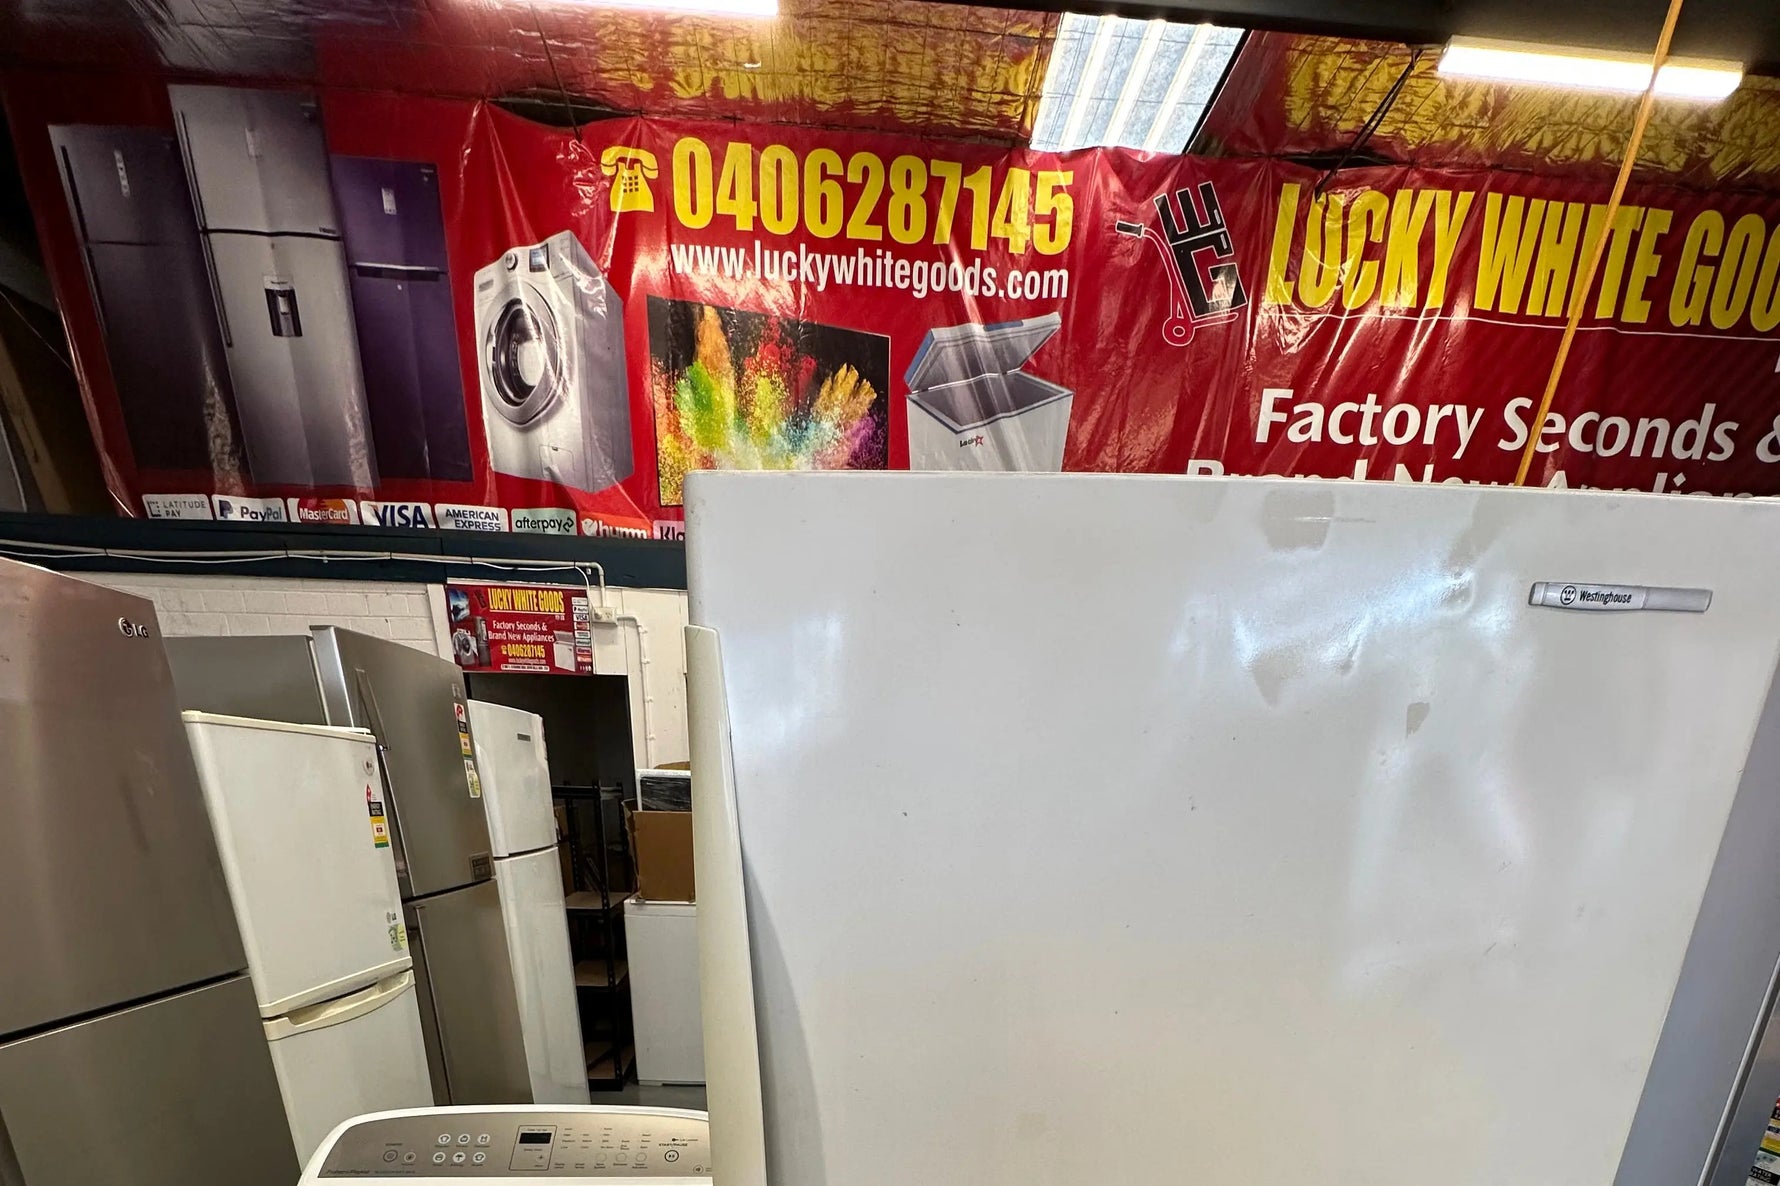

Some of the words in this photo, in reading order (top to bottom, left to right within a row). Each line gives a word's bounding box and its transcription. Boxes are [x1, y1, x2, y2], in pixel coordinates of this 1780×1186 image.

[672, 137, 1074, 255] 0406287145
[1264, 183, 1476, 310] LUCKY
[1474, 191, 1674, 323] WHITE
[670, 240, 1069, 300] www.luckywhitegoods.com
[1255, 388, 1485, 460] Factory
[1498, 396, 1740, 462] Seconds
[163, 500, 206, 509] LATITUDE
[165, 510, 181, 518] PAY
[240, 505, 282, 521] PayPal
[299, 506, 348, 520] MasterCard
[369, 504, 429, 528] VISA
[445, 508, 499, 521] AMERICAN
[455, 519, 501, 531] EXPRESS
[515, 517, 562, 533] afterpay
[488, 588, 512, 610] LUCKY
[512, 589, 538, 611] WHITE
[538, 590, 565, 613] GOODS
[1579, 590, 1632, 605] Westinghouse
[492, 620, 515, 631] Factory
[516, 621, 541, 631] Seconds
[541, 622, 548, 631] &
[488, 630, 507, 640] Brand
[507, 631, 521, 640] New
[523, 632, 555, 643] Appliances
[507, 643, 546, 658] 0406287145
